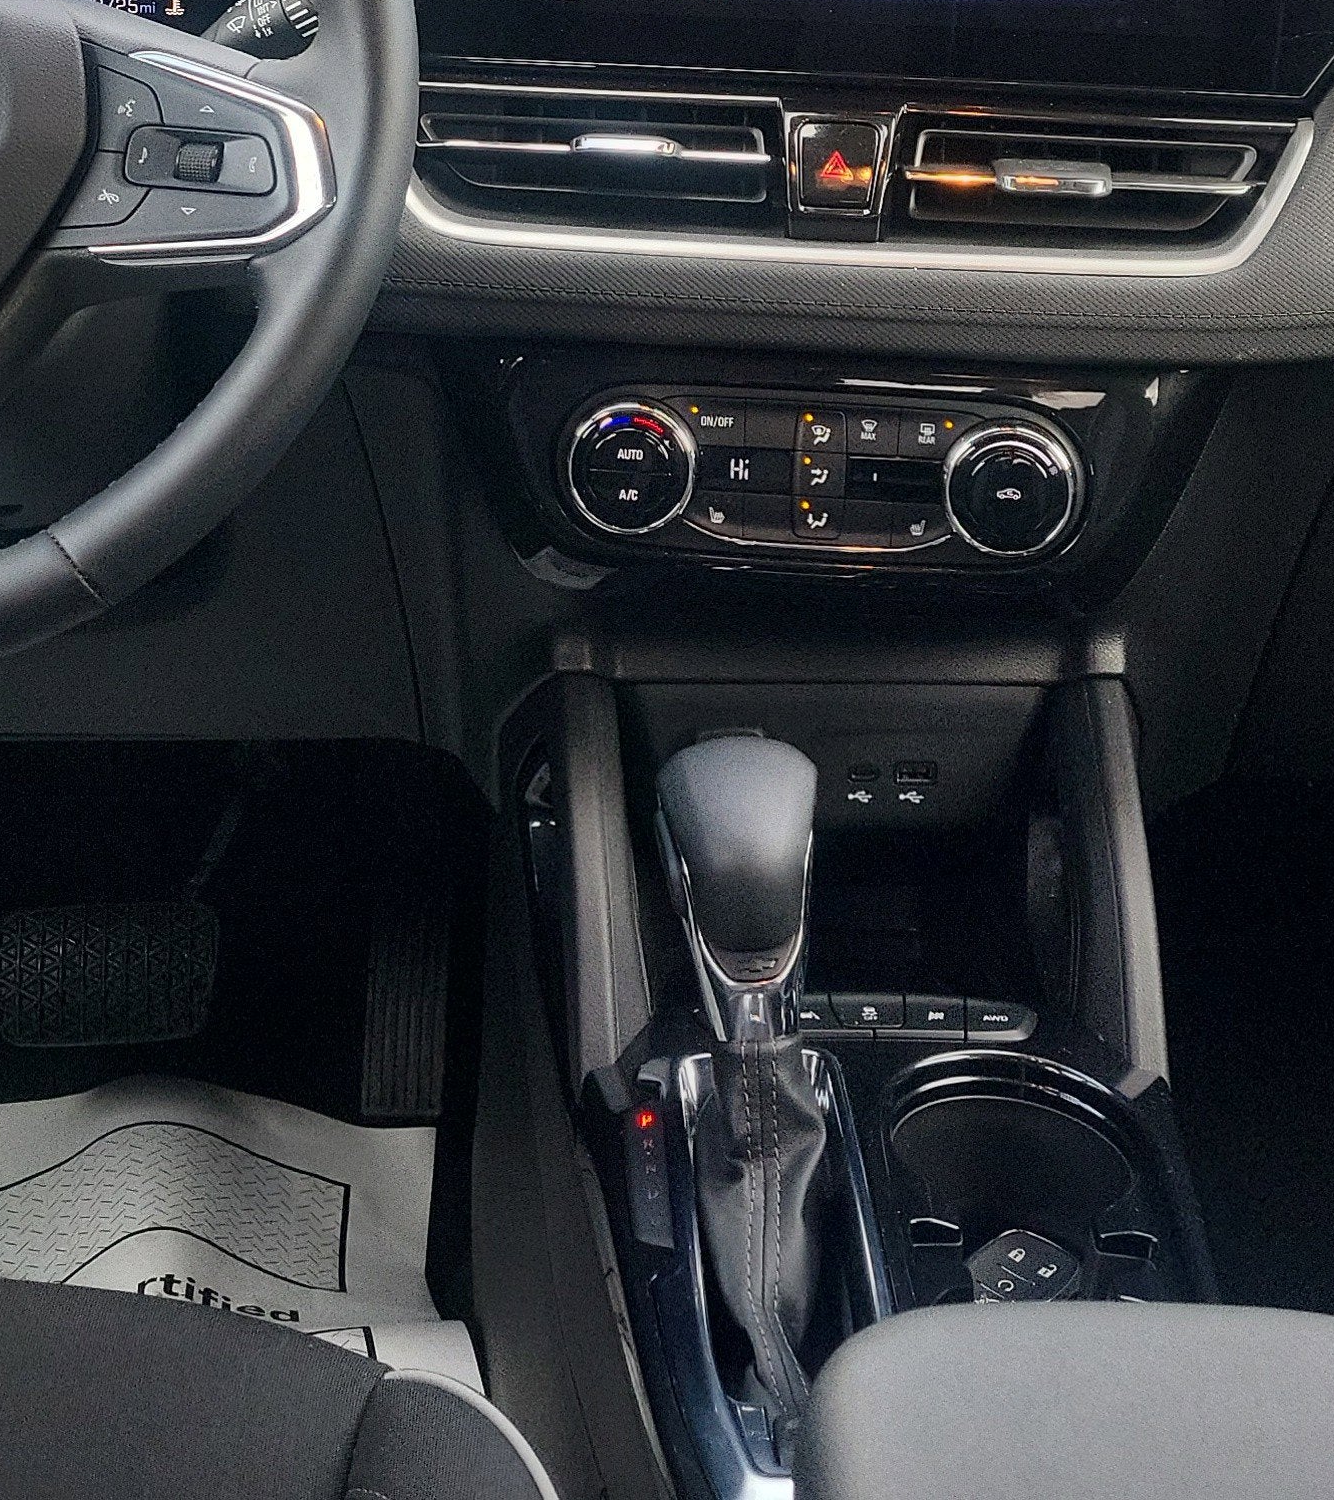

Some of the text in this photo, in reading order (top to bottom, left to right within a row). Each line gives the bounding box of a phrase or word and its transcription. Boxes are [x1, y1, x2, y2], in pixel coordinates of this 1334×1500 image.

[700, 415, 734, 429] ON/OFF
[861, 431, 877, 441] MAX
[918, 436, 936, 446] REAR
[617, 447, 643, 462] AUTO
[619, 488, 638, 502] A/C
[983, 1014, 1008, 1023] AWD
